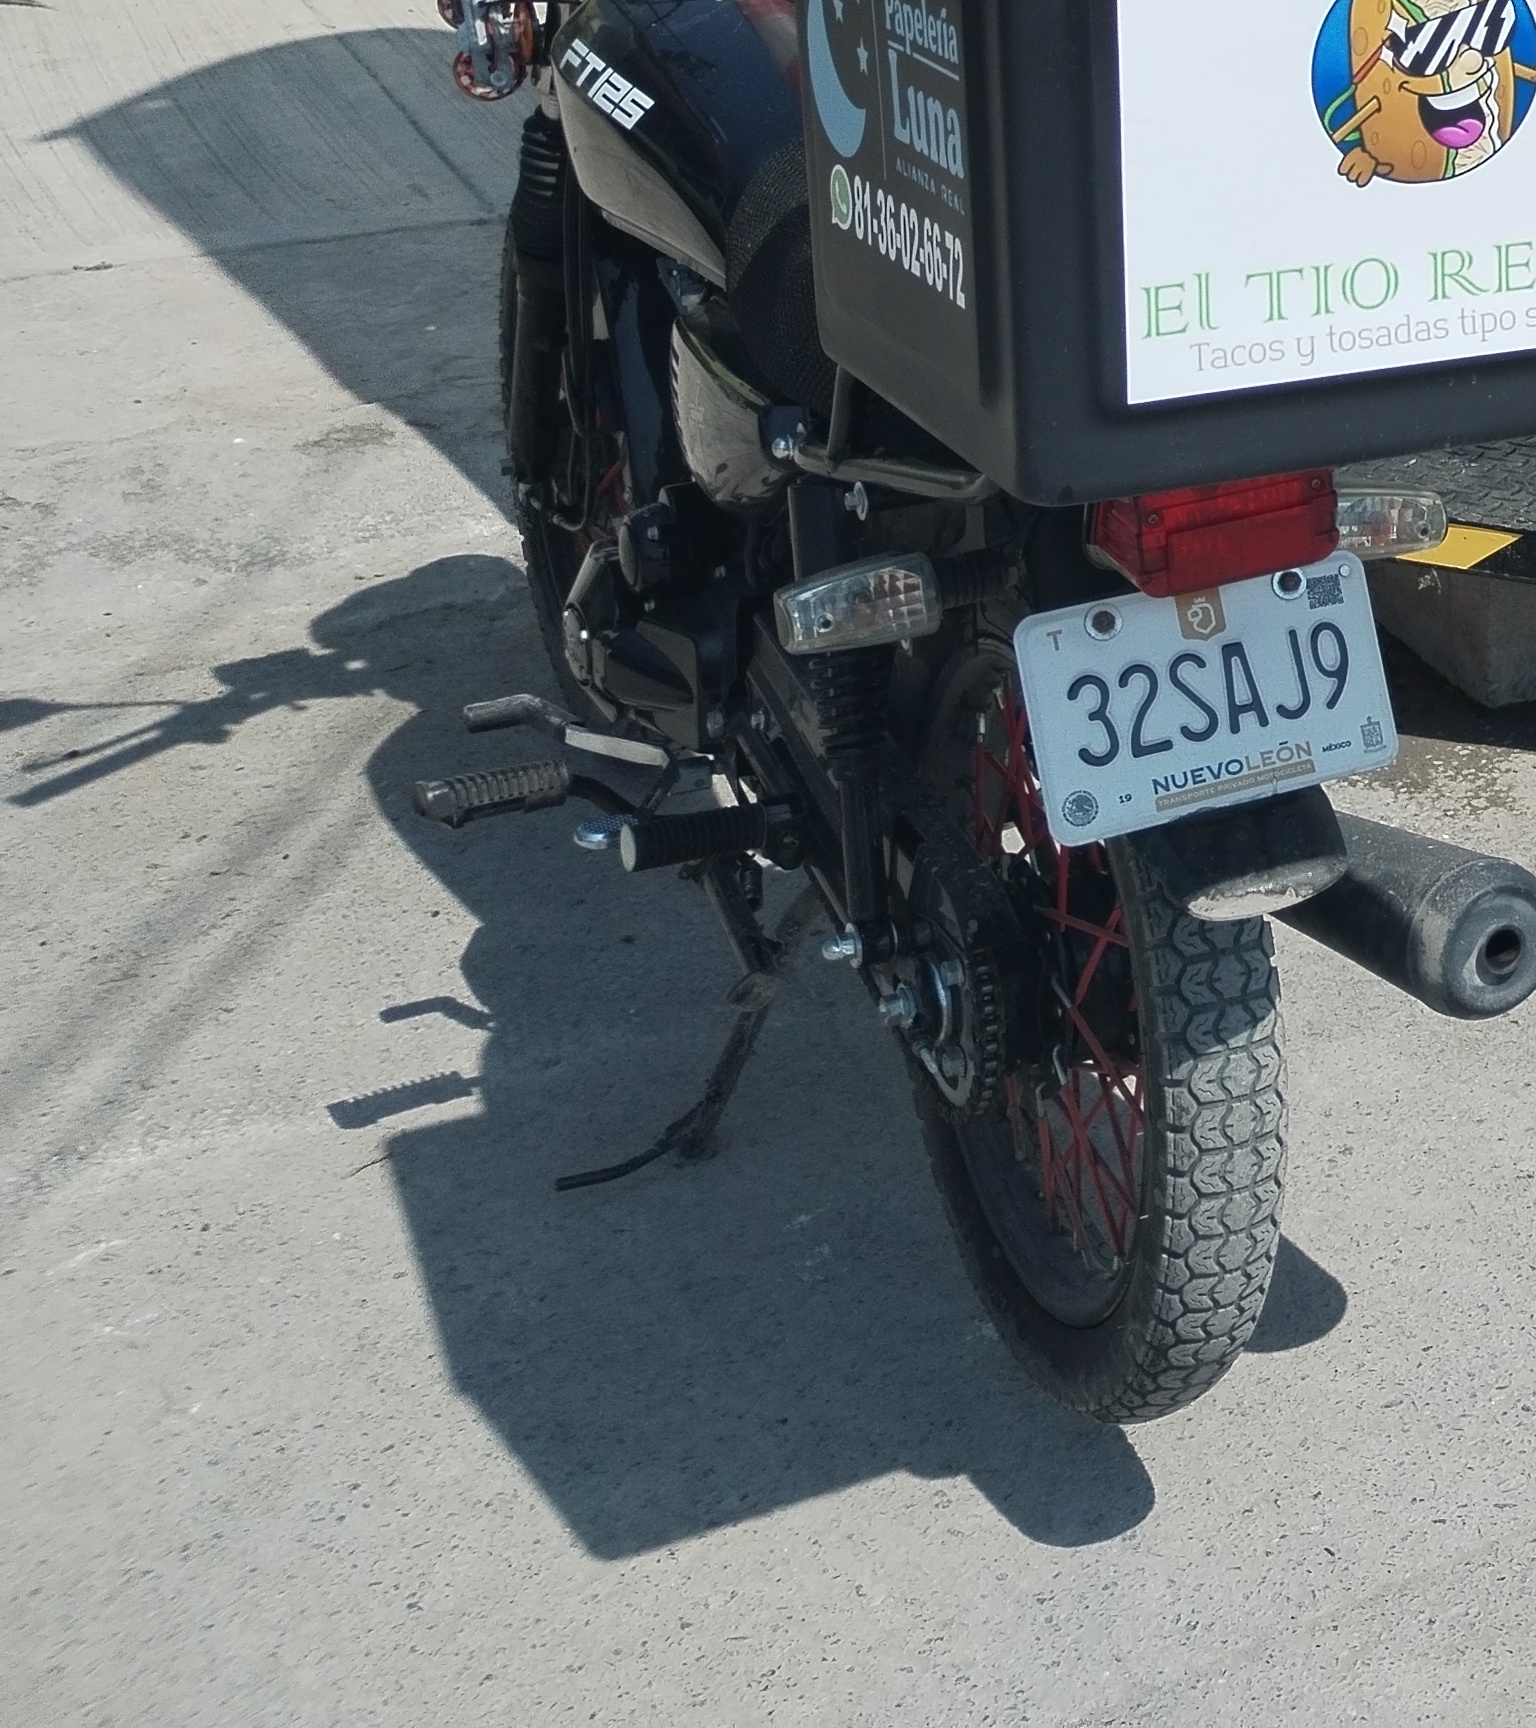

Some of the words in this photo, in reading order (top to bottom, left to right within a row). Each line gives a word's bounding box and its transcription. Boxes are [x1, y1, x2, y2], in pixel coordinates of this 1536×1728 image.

[559, 38, 655, 130] FT125
[888, 48, 965, 180] Luna
[896, 157, 936, 195] ALIANZA
[941, 184, 966, 216] REAL
[854, 175, 966, 310] 81-36-02-66-72
[1141, 272, 1219, 340] El
[1244, 257, 1399, 323] TIO
[1189, 333, 1284, 372] Tacos
[1294, 333, 1316, 367] y
[1326, 314, 1450, 354] tosadas
[1459, 307, 1517, 343] tipo
[1046, 629, 1063, 652] T
[1066, 621, 1349, 767] 32SAJ9
